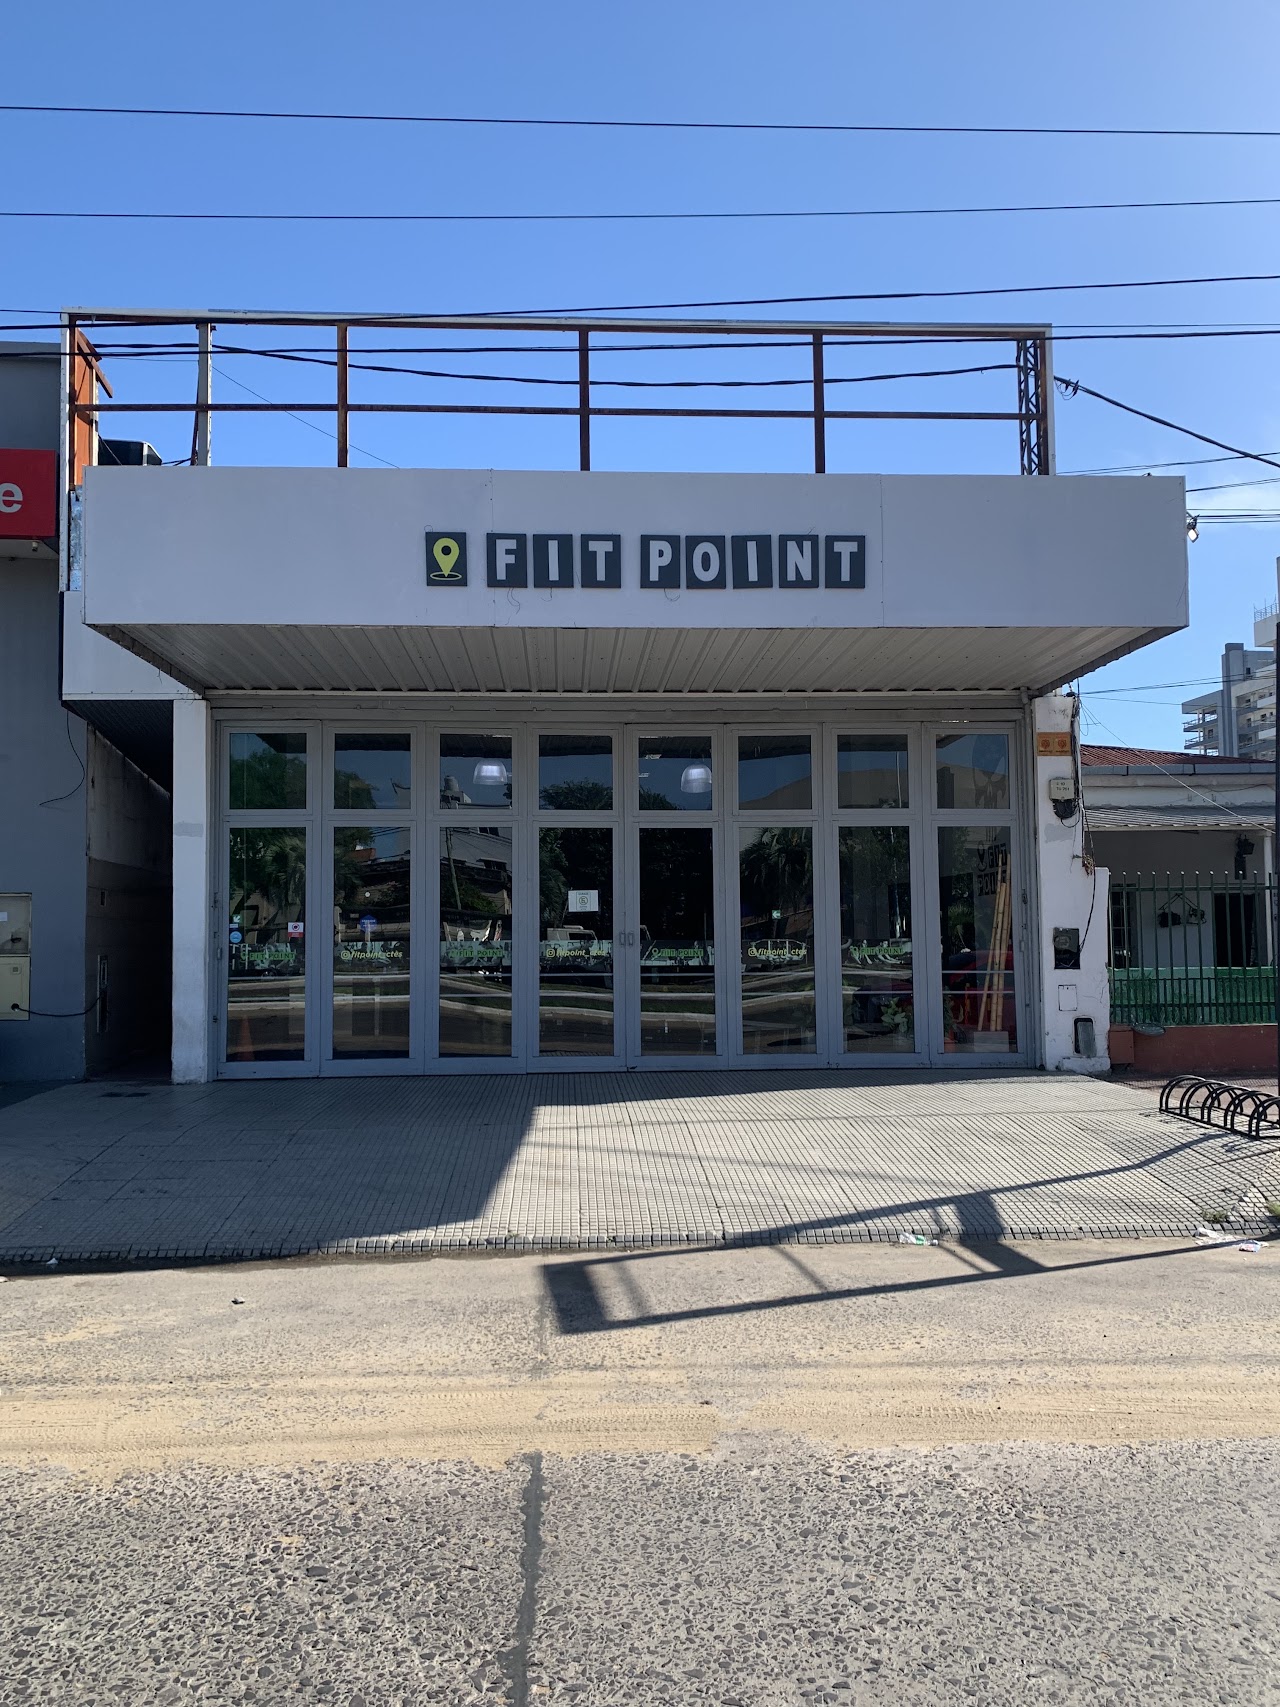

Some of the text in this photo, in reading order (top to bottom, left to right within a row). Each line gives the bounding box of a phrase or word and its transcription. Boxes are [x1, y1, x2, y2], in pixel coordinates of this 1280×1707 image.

[495, 538, 858, 583] FIT POINT
[250, 952, 296, 960] FIT POINT
[477, 949, 504, 958] POINT
[678, 948, 704, 957] POINT
